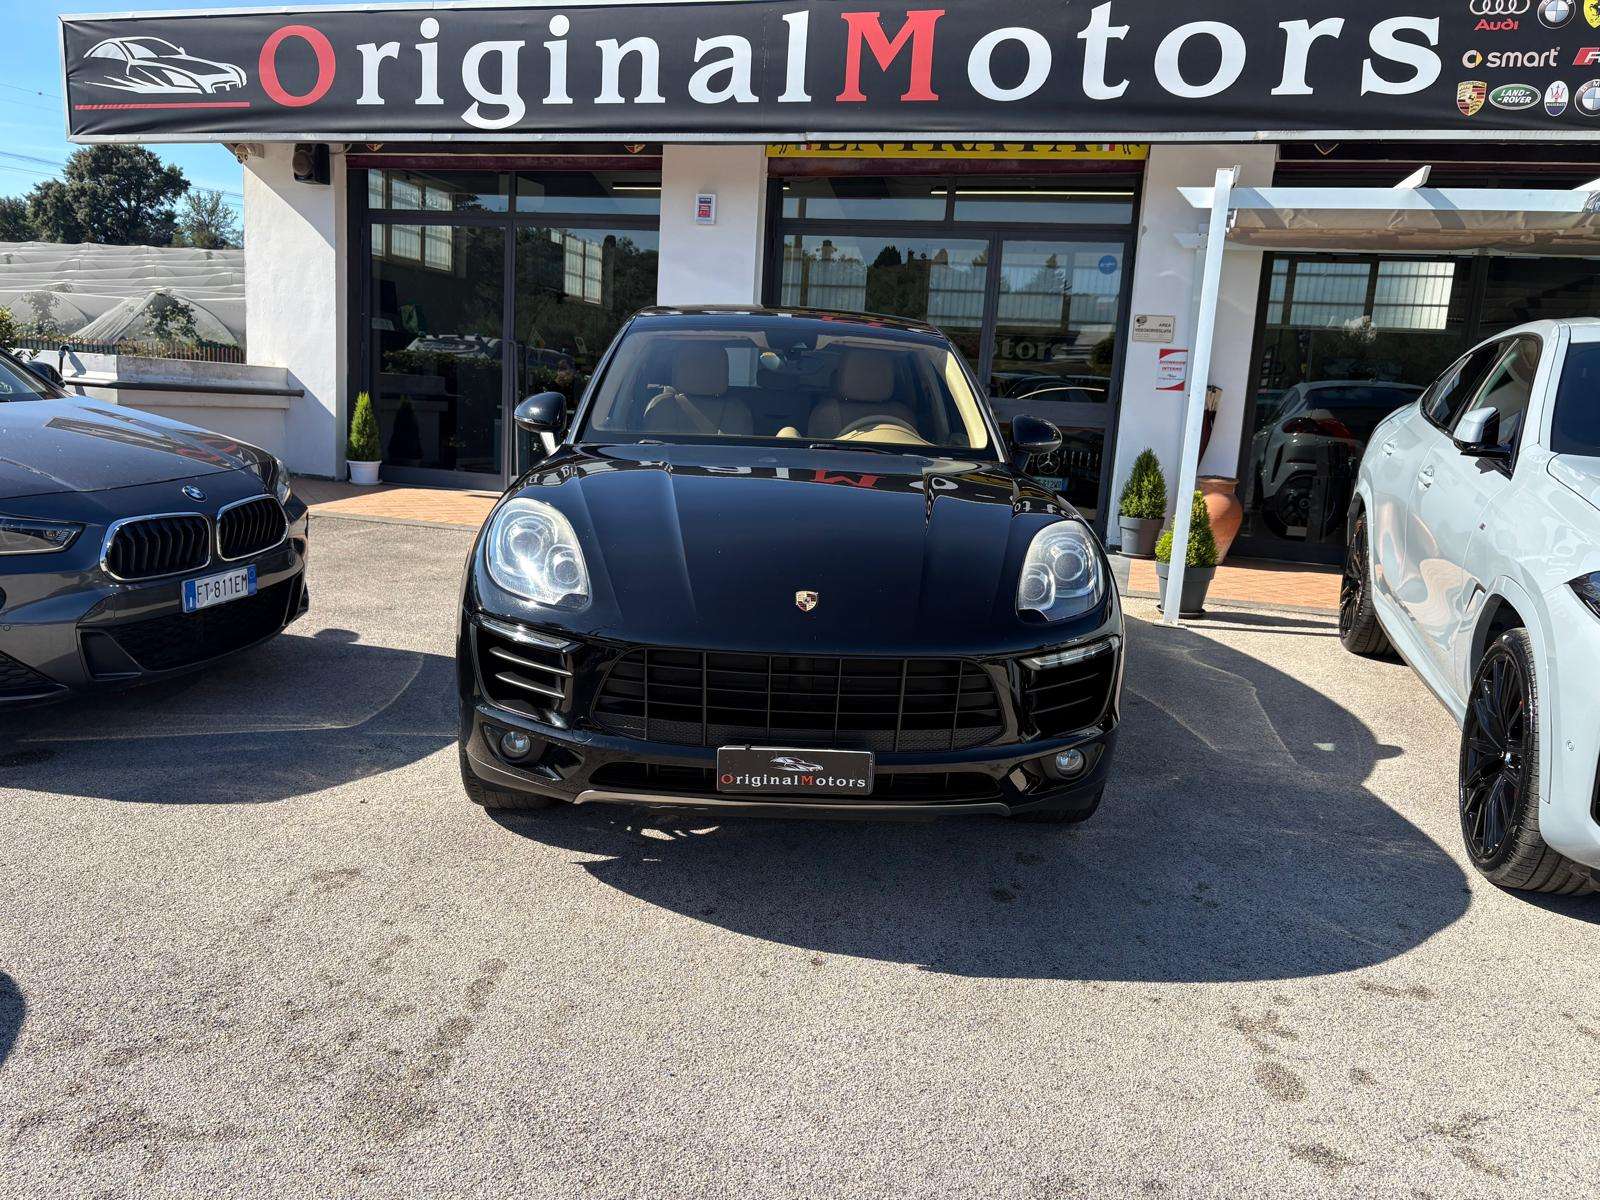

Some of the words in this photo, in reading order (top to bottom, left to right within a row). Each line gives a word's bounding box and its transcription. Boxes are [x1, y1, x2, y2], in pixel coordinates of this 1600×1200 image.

[1473, 18, 1519, 31] Audi
[1486, 48, 1558, 67] smart
[1501, 89, 1525, 97] LAND
[1502, 96, 1532, 104] ROVER
